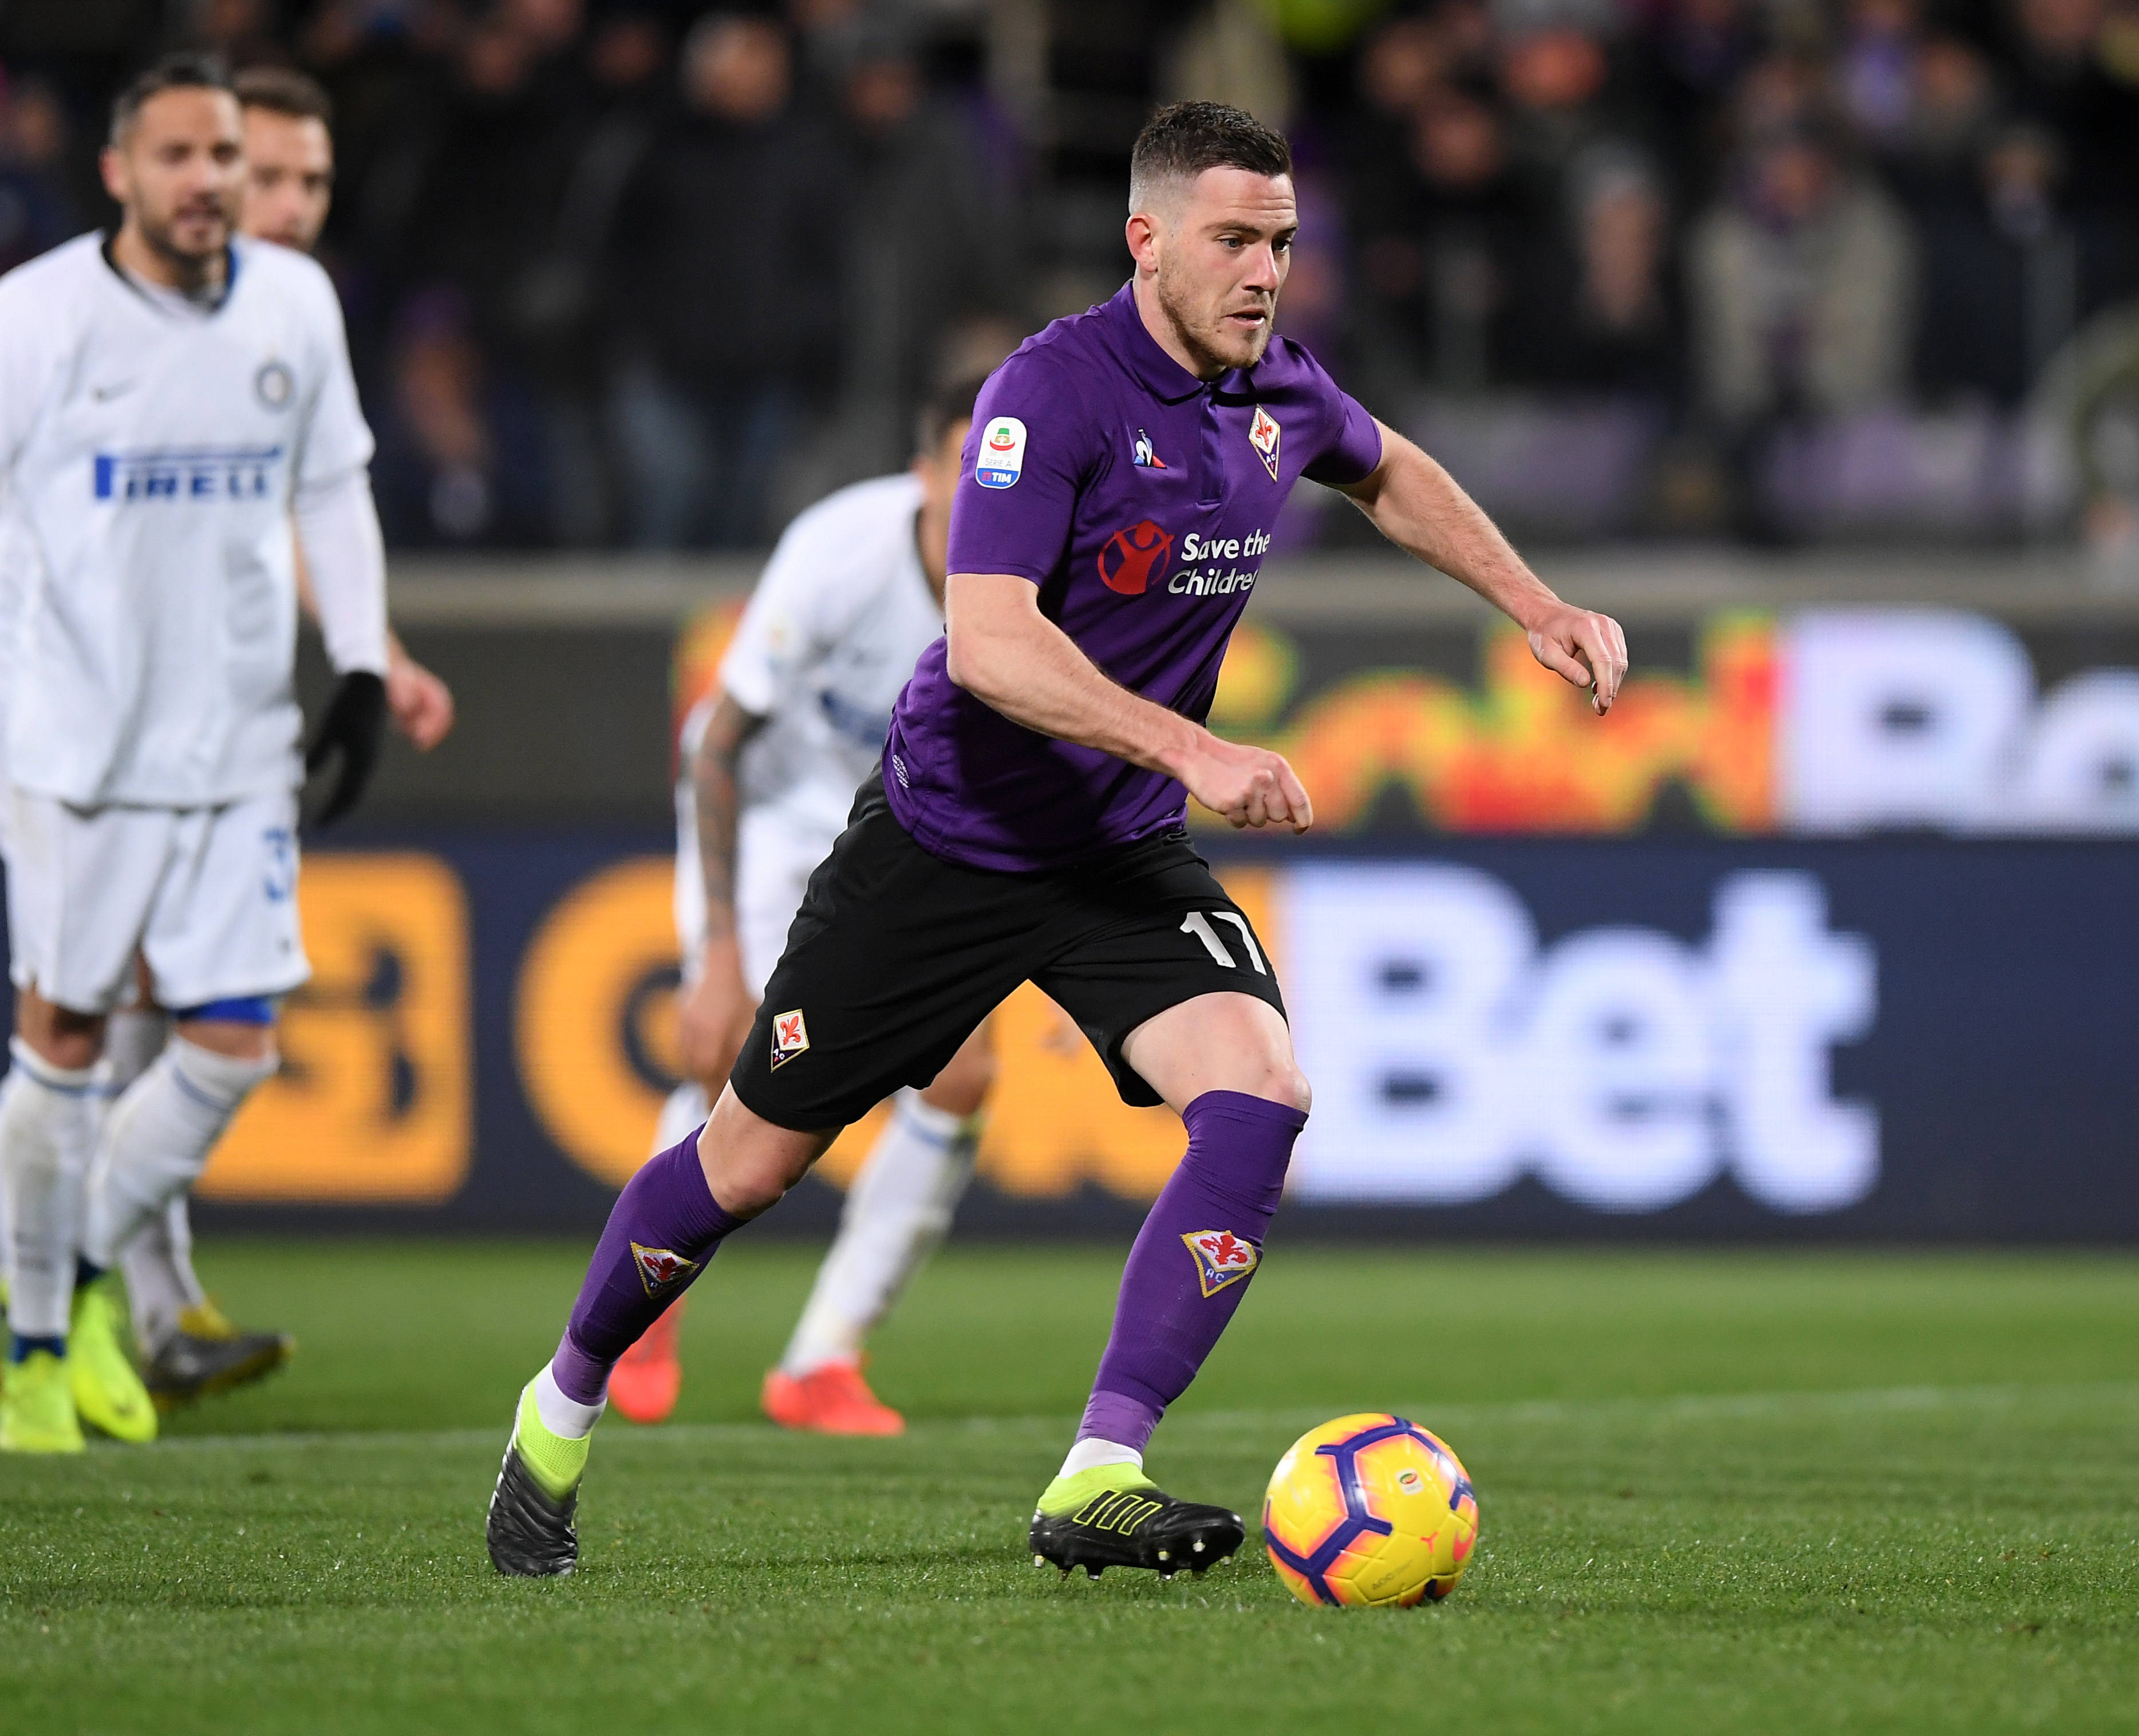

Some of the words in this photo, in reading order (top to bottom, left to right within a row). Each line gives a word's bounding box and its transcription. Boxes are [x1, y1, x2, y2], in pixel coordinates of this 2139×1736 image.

[985, 458, 1003, 467] SERIE
[992, 472, 1012, 483] TIM
[1181, 533, 1240, 561] Save
[1243, 528, 1270, 557] the
[1179, 911, 1267, 976] 17
